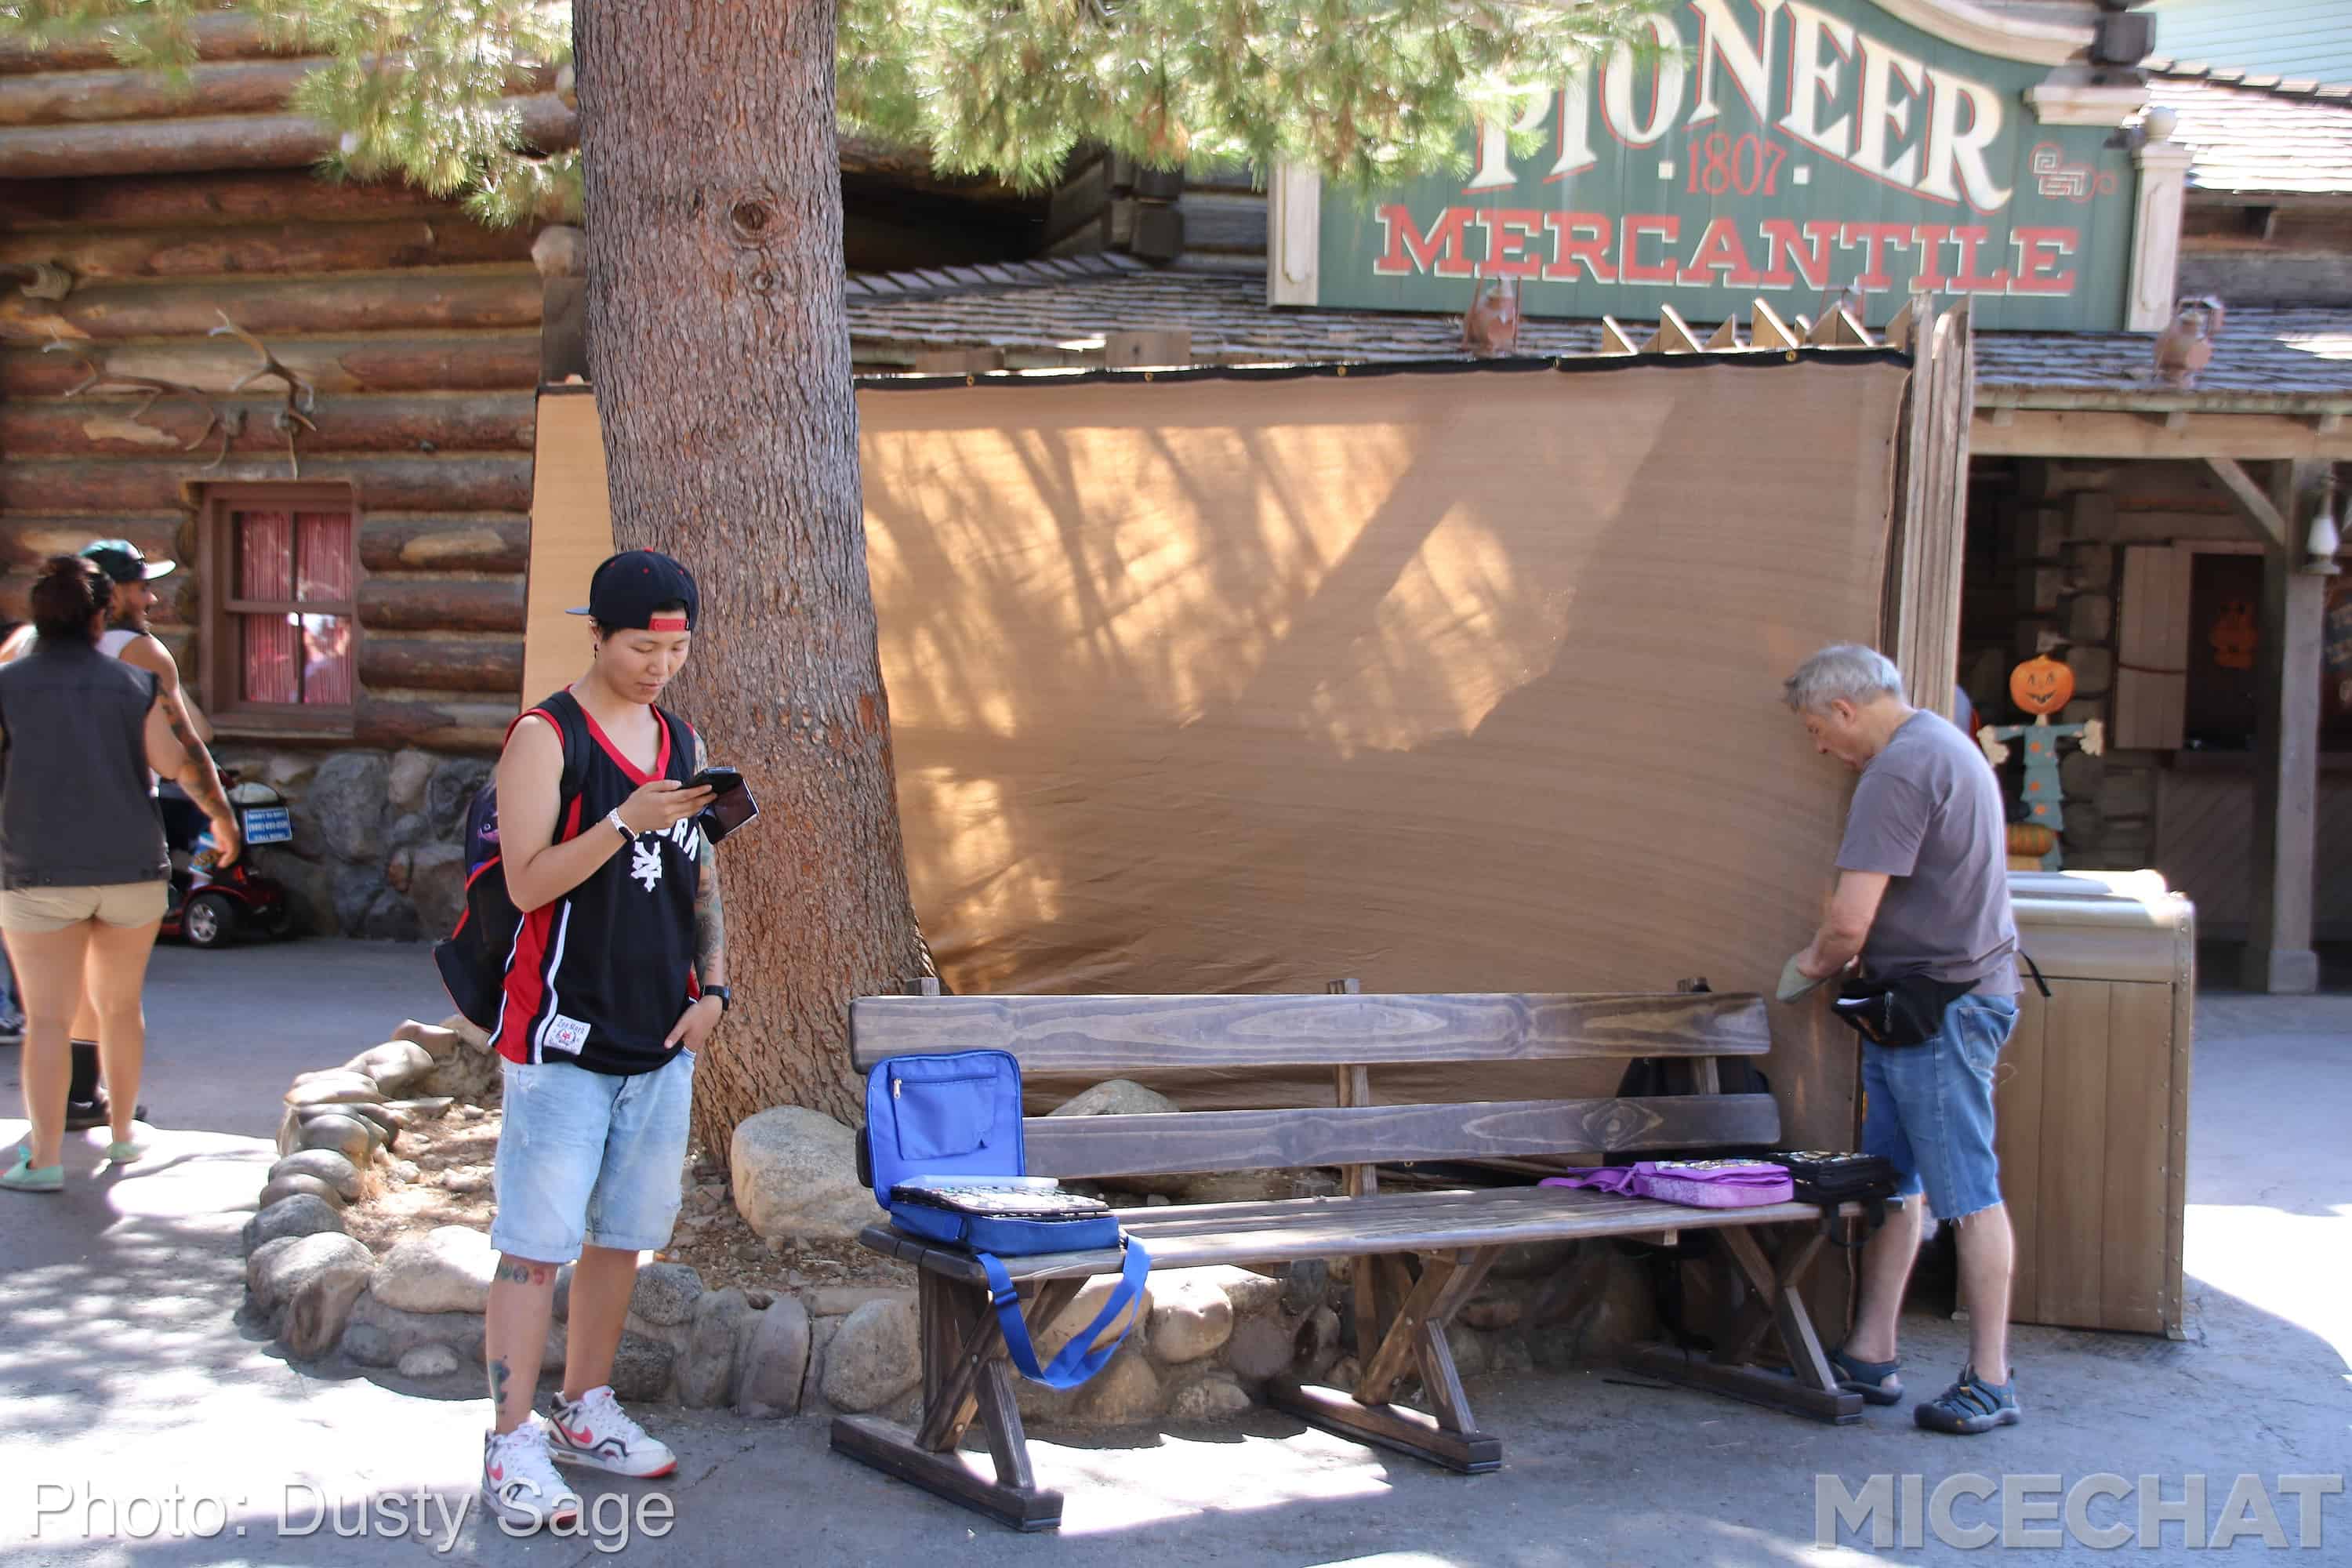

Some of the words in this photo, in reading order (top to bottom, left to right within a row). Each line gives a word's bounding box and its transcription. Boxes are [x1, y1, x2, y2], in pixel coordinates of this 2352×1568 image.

[1461, 0, 2012, 214] PIONEER
[1686, 132, 1787, 196] 1807
[1374, 205, 2078, 296] MERCANTILE
